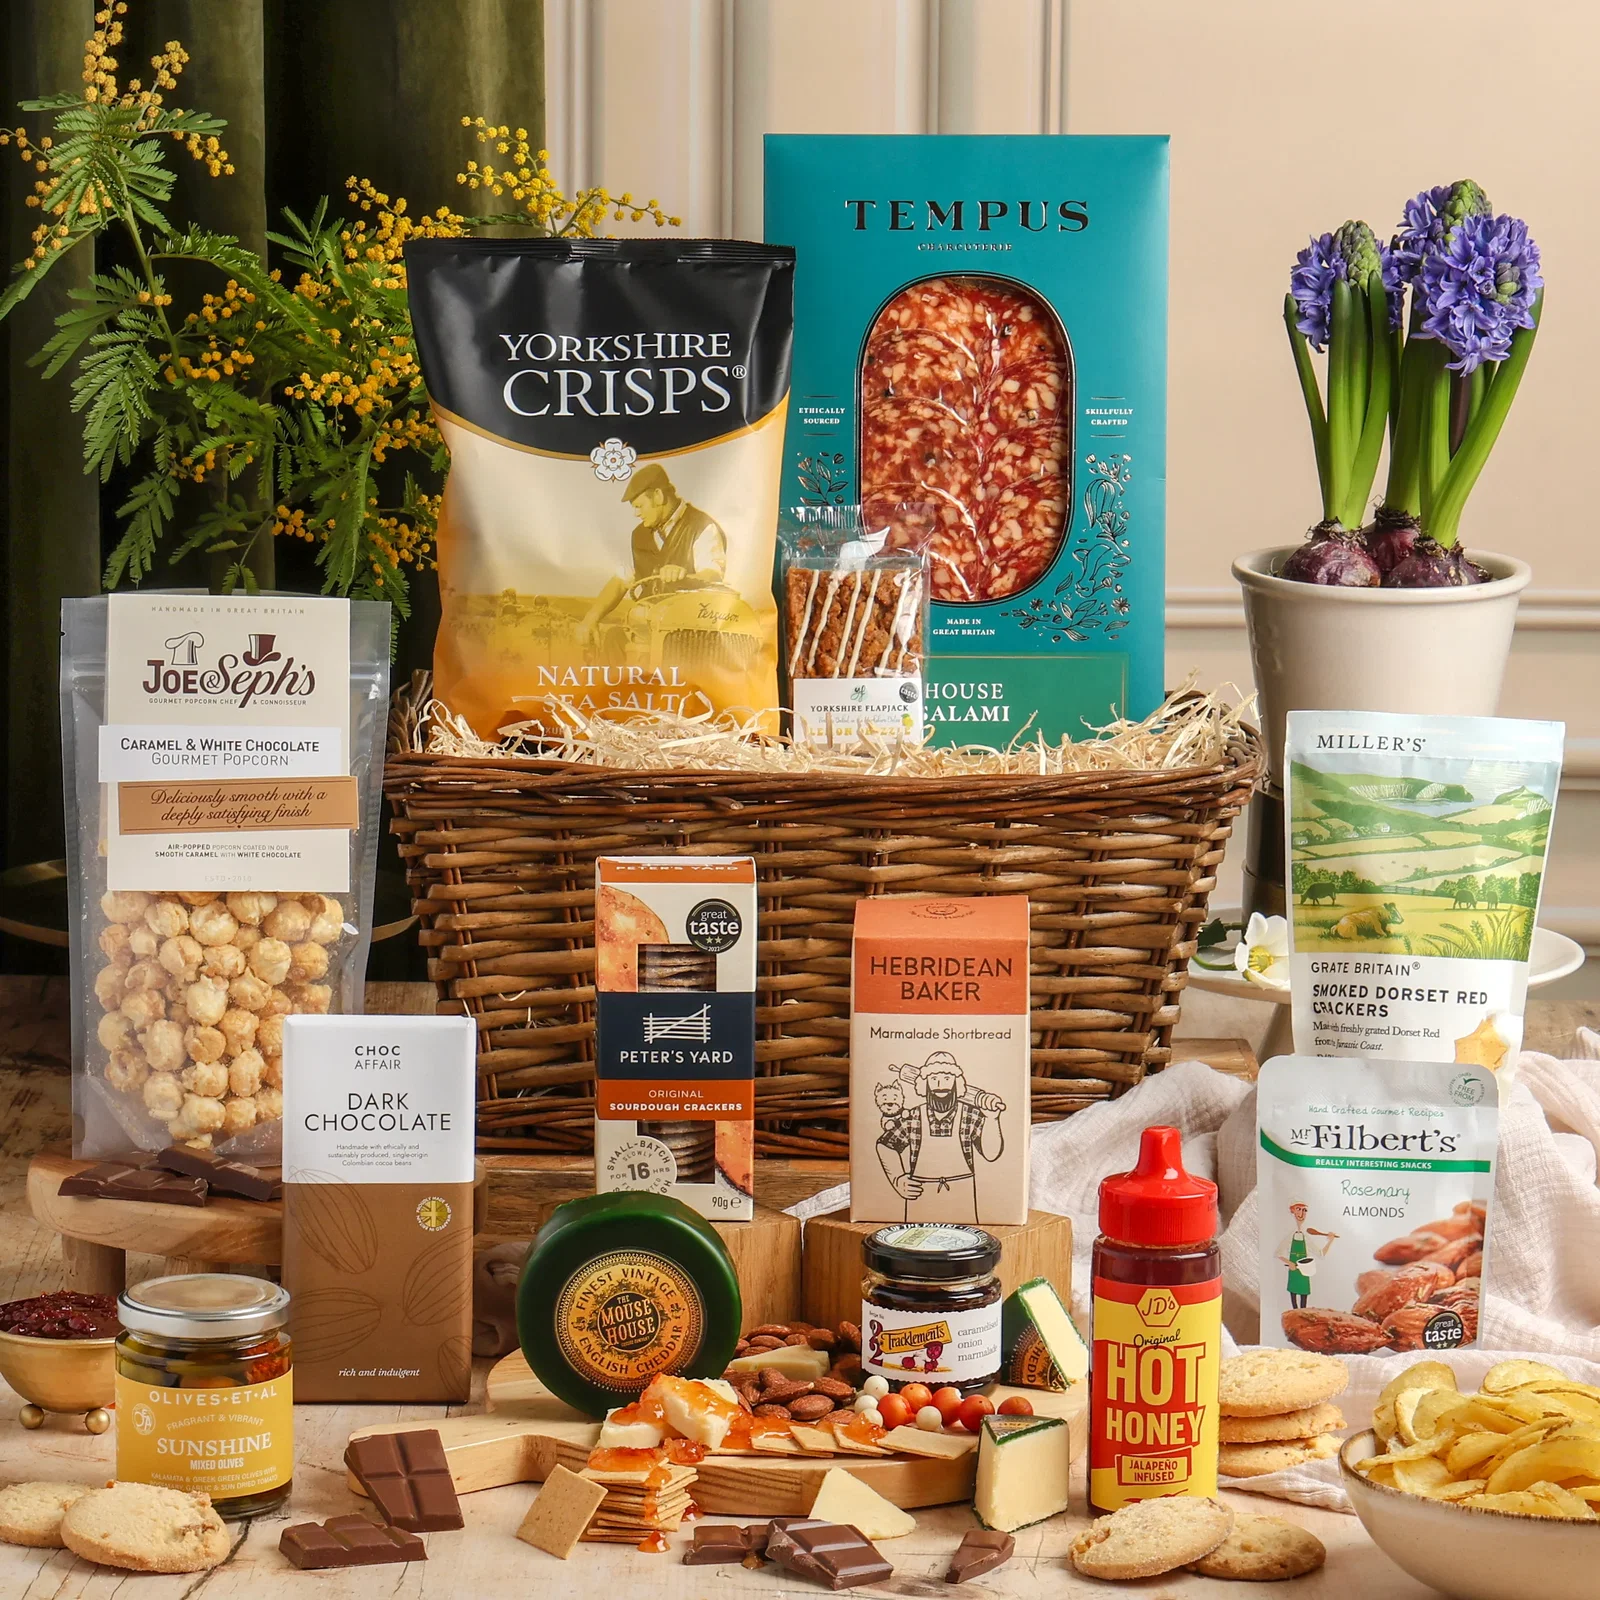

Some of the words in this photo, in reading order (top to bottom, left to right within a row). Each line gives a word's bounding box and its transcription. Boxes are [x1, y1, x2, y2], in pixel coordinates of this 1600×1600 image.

[844, 200, 1090, 232] TEMPUS
[917, 243, 1012, 252] CHARCUTERIE
[499, 333, 732, 362] YORKSHIRE
[798, 407, 846, 415] ETHICALLY
[1085, 408, 1134, 416] SKILLFULLY
[803, 417, 840, 425] SOURCED
[932, 628, 960, 636] GREAT
[961, 628, 995, 636] BRITAIN
[537, 665, 687, 687] NATURAL
[925, 683, 1004, 700] HOUSE
[607, 691, 681, 713] SALT
[811, 705, 862, 713] YORKSHIRE
[865, 705, 909, 713] FLAPJACK
[809, 727, 852, 736] LEON
[120, 738, 183, 751] CARAMEL
[186, 739, 197, 751] &
[200, 739, 242, 752] WHITE
[245, 739, 320, 752] CHOCOLATE
[151, 753, 218, 766] GOURMET
[223, 753, 289, 766] POPCORN
[150, 788, 226, 807] Deliciously
[229, 786, 280, 801] smooth
[283, 785, 314, 801] with
[317, 790, 328, 800] a
[161, 807, 204, 826] deeply
[206, 804, 273, 824] satisfying
[268, 801, 313, 823] finish
[701, 910, 727, 921] great
[689, 920, 740, 936] taste
[871, 956, 1012, 977] HEBRIDEAN
[1311, 962, 1349, 974] GRATE
[901, 981, 981, 1001] BAKER
[1313, 984, 1368, 999] SMOKED
[1376, 986, 1449, 1003] DORSET
[1457, 991, 1488, 1005] RED
[1313, 1002, 1389, 1018] CRACKERS
[870, 1027, 940, 1040] Marmalade
[943, 1027, 1012, 1040] Shortbread
[1340, 1022, 1364, 1036] freshly
[1365, 1026, 1390, 1037] grated
[1392, 1026, 1421, 1037] Dorset
[1423, 1028, 1440, 1038] Red
[355, 1046, 401, 1056] CHOC
[620, 1050, 684, 1063] PETER'S
[690, 1051, 733, 1063] YARD
[354, 1060, 401, 1070] AFFAIR
[348, 1093, 409, 1110] DARK
[648, 1090, 704, 1098] ORIGINAL
[610, 1103, 680, 1111] SOURDOUGH
[683, 1103, 743, 1111] CRACKERS
[1309, 1105, 1328, 1114] Hand
[1332, 1104, 1368, 1115] Crafted
[1372, 1107, 1405, 1116] Gourmet
[1409, 1108, 1445, 1121] Recipes
[304, 1114, 451, 1131] CHOCOLATE
[1311, 1124, 1457, 1153] Filbert's
[383, 1144, 407, 1152] ethically
[607, 1140, 671, 1171] SMALL-BATCH
[627, 1162, 650, 1181] 16
[1316, 1159, 1344, 1167] REALLY
[1346, 1159, 1399, 1169] INTERESTING
[1401, 1161, 1432, 1170] SNACKS
[1341, 1179, 1411, 1204] Rosemary
[711, 1197, 729, 1210] 90g
[1343, 1206, 1404, 1218] ALMONDS
[576, 1271, 613, 1310] FINEST
[622, 1268, 677, 1300] VINTAGE
[617, 1295, 630, 1304] THE
[1141, 1296, 1175, 1316] JD's
[600, 1299, 652, 1327] MOUSE
[606, 1317, 655, 1346] HOUSE
[1434, 1319, 1454, 1330] great
[880, 1323, 945, 1350] Tracklements
[1133, 1329, 1181, 1350] Original
[1425, 1328, 1462, 1342] taste
[579, 1337, 629, 1375] ENGLISH
[636, 1325, 683, 1373] CHEDDAR
[957, 1338, 983, 1349] onion
[338, 1368, 356, 1377] rich
[358, 1368, 376, 1377] and
[378, 1368, 420, 1379] indulgent
[1107, 1343, 1205, 1406] HOT
[166, 1414, 215, 1431] FRAGRANT
[218, 1414, 226, 1422] &
[229, 1414, 264, 1427] VIBRANT
[1106, 1408, 1204, 1445] HONEY
[157, 1432, 272, 1457] SUNSHINE
[190, 1459, 215, 1470] MIXED
[218, 1457, 244, 1470] OLIVES
[1129, 1458, 1178, 1470] JALAPEÑO
[151, 1472, 184, 1482] KALAMATA
[242, 1471, 262, 1480] OLIVES
[237, 1480, 256, 1489] DRIED
[257, 1474, 278, 1484] TOMATO
[1134, 1471, 1174, 1482] INFUSED
